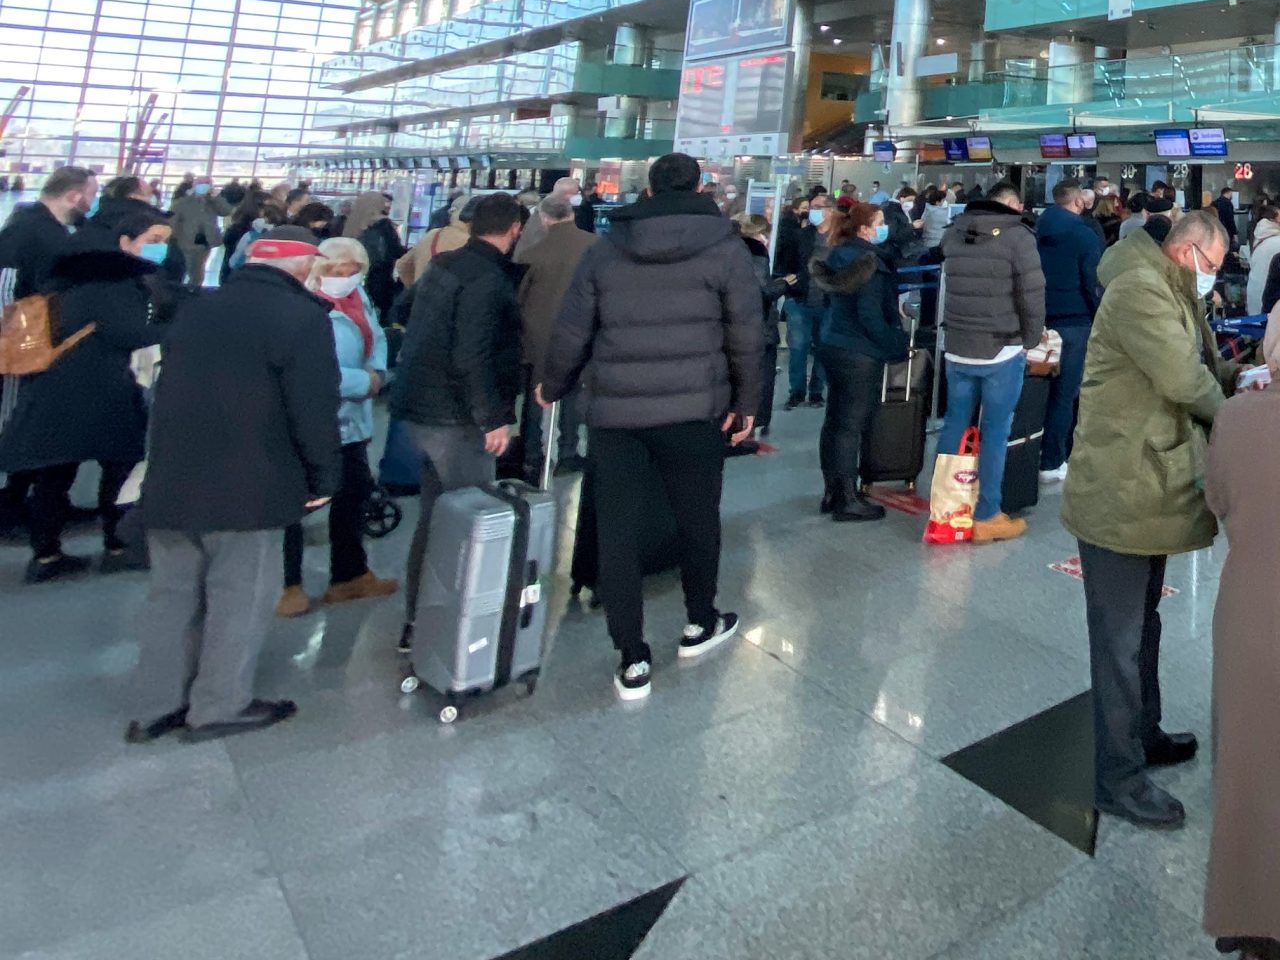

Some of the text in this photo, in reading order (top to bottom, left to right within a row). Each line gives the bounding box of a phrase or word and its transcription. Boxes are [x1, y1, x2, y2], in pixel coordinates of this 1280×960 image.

[1071, 165, 1084, 178] 31
[1121, 165, 1135, 178] 30
[1173, 164, 1188, 178] 29
[1234, 163, 1253, 179] 28
